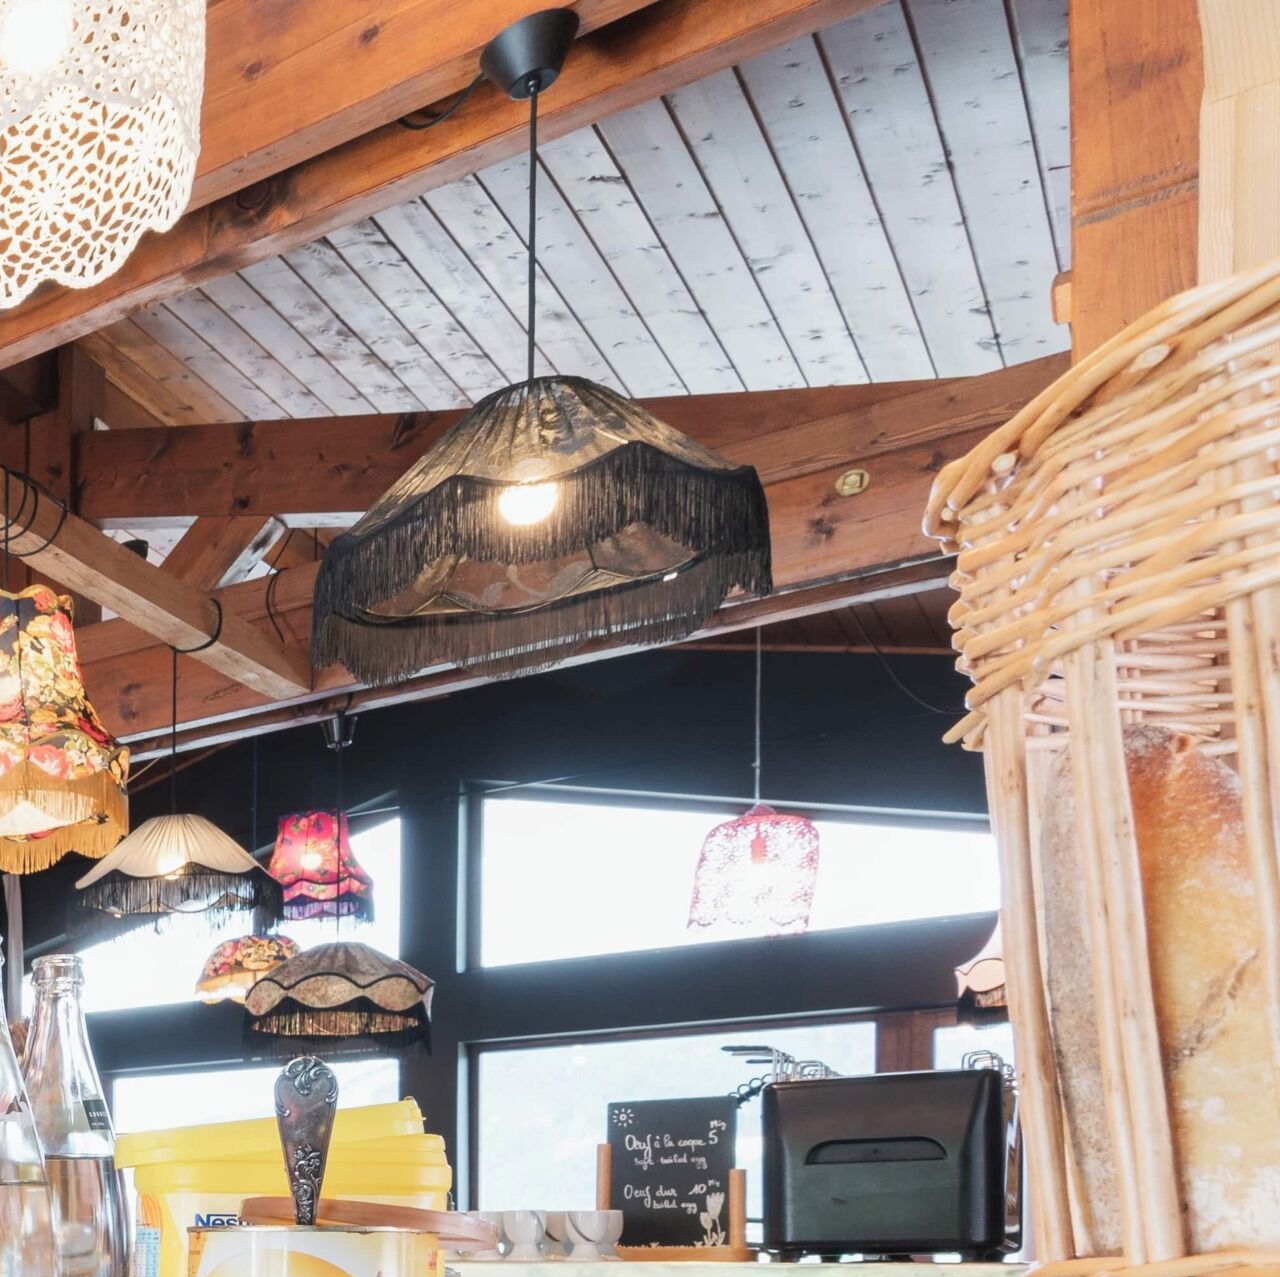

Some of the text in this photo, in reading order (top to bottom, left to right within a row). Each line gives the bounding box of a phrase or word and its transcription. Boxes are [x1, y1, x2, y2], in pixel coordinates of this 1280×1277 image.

[625, 1129, 719, 1159] Oeuf à la coque 5
[691, 1156, 708, 1170] egg
[624, 1183, 708, 1208] Oeuf dur 10
